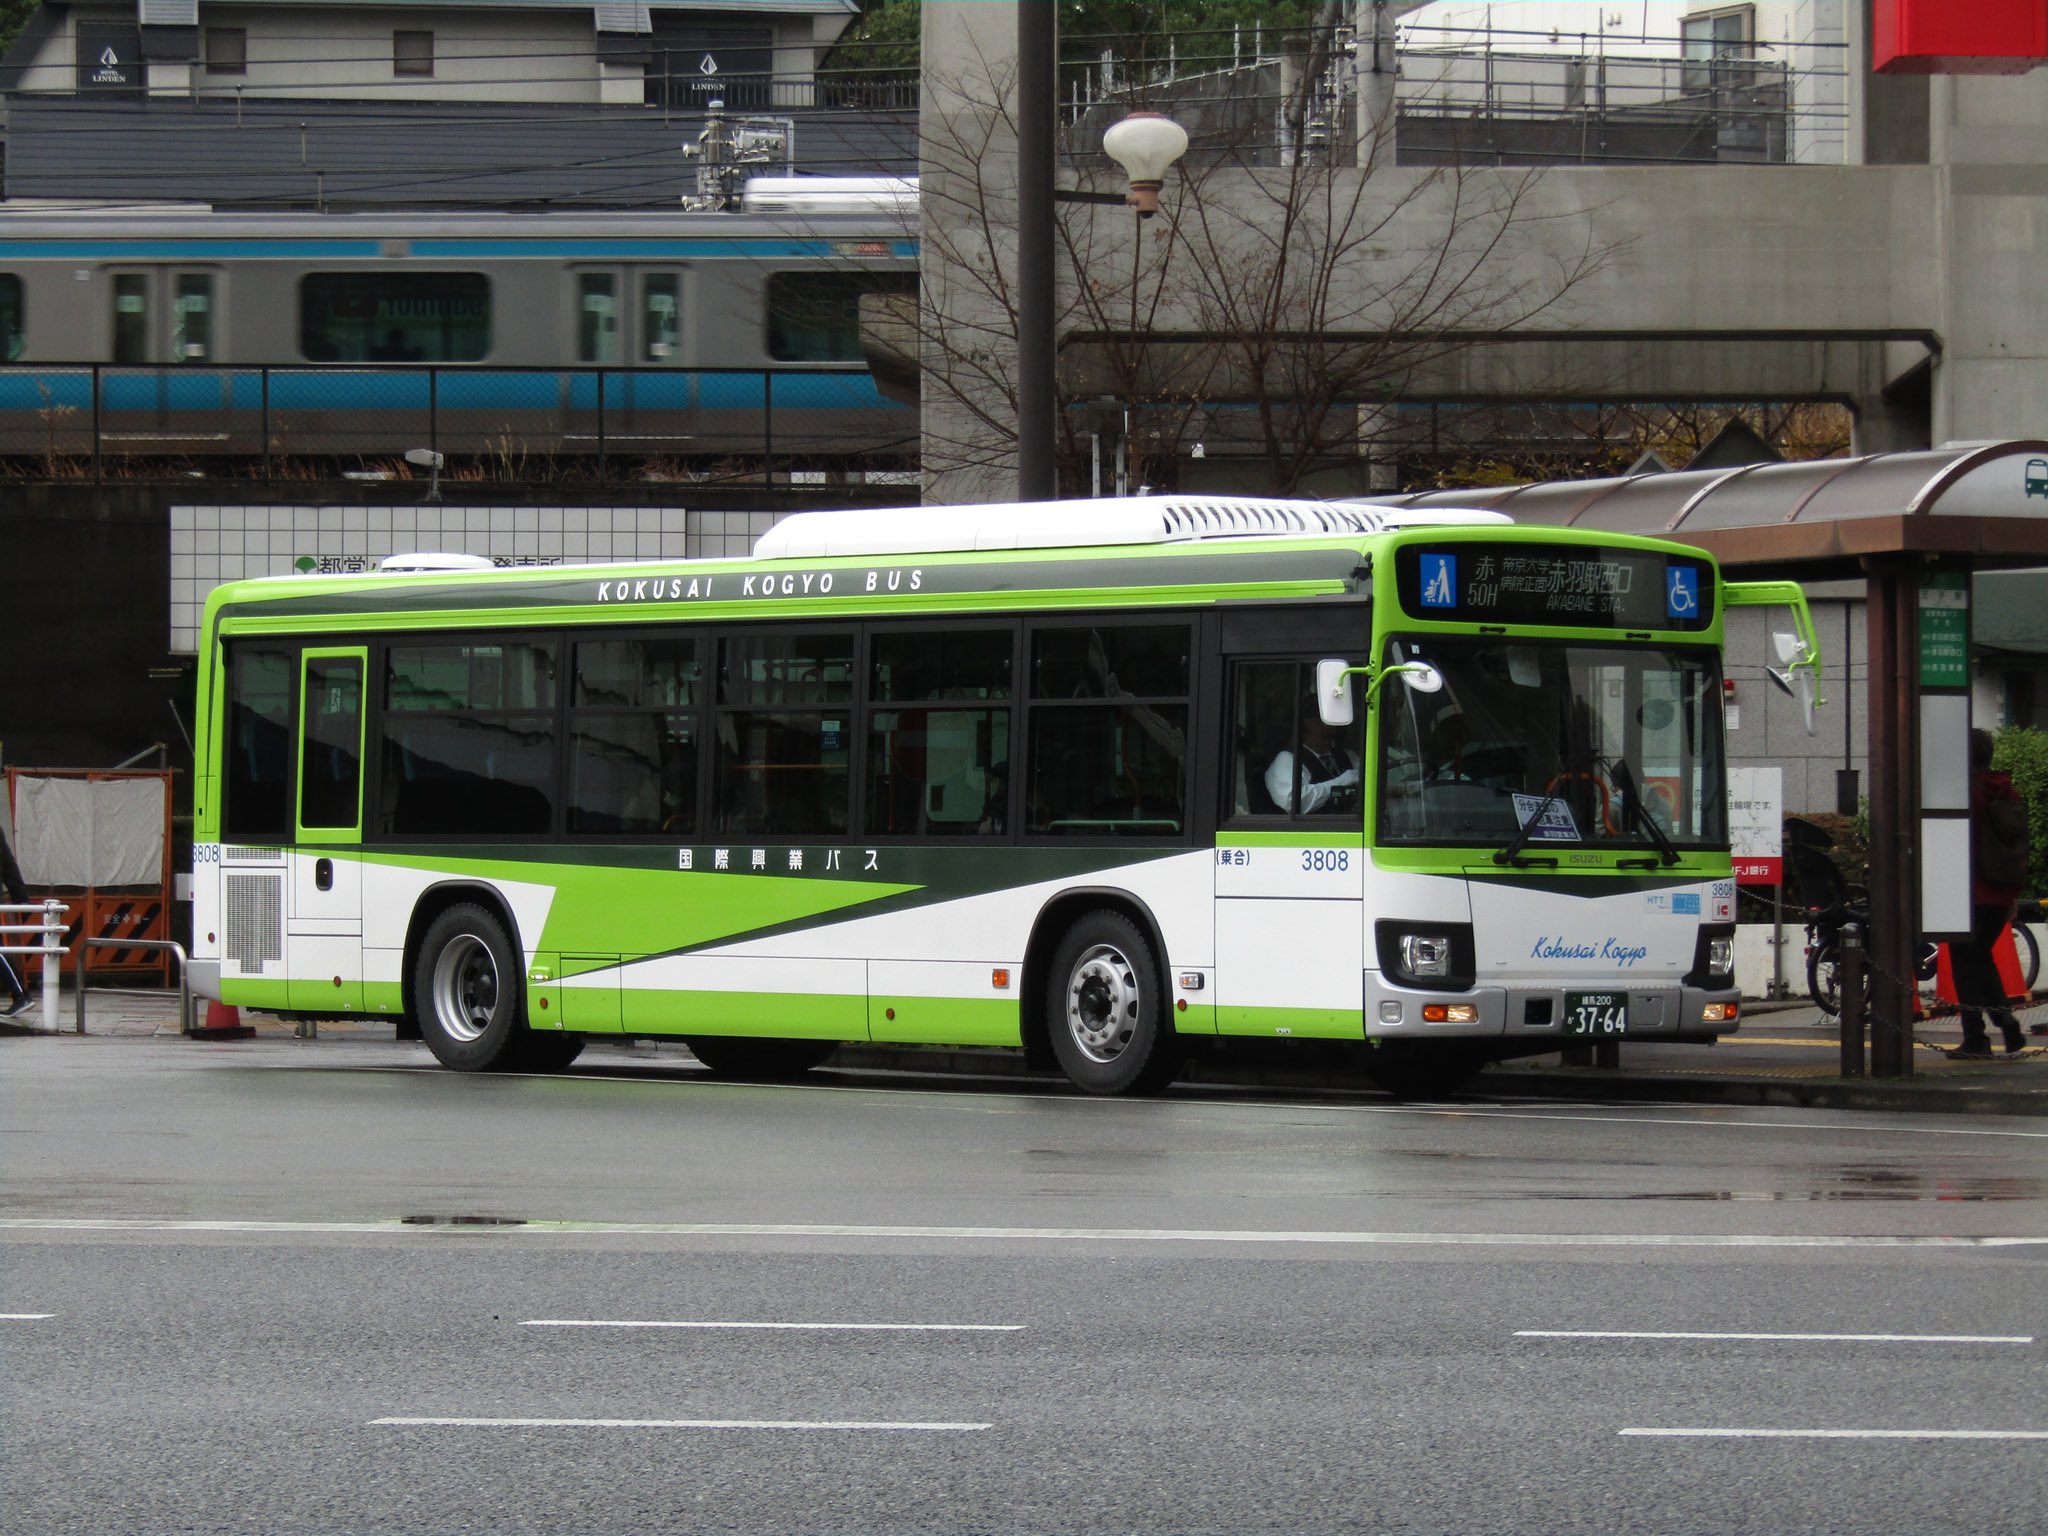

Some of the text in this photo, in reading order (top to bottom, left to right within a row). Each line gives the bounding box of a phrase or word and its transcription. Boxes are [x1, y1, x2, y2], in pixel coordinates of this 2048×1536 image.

[92, 75, 126, 83] LINDEN
[691, 83, 726, 91] LINDEN
[1475, 555, 1495, 581] 赤
[1548, 560, 1632, 594] 赤羽駅西口
[598, 569, 922, 602] KOKUSAI KOGYO BUS
[1467, 582, 1498, 607] 50H
[1546, 595, 1594, 612] AKABANE
[678, 849, 878, 871] 国際興業バス
[1216, 849, 1250, 866] (乗合)
[1301, 850, 1349, 872] 3808
[1568, 854, 1603, 864] ISUZU
[1647, 896, 1665, 905] HTT
[1712, 883, 1733, 896] 3808
[1531, 936, 1647, 968] Kokusai Kogyo
[1575, 1007, 1626, 1033] 37-64
